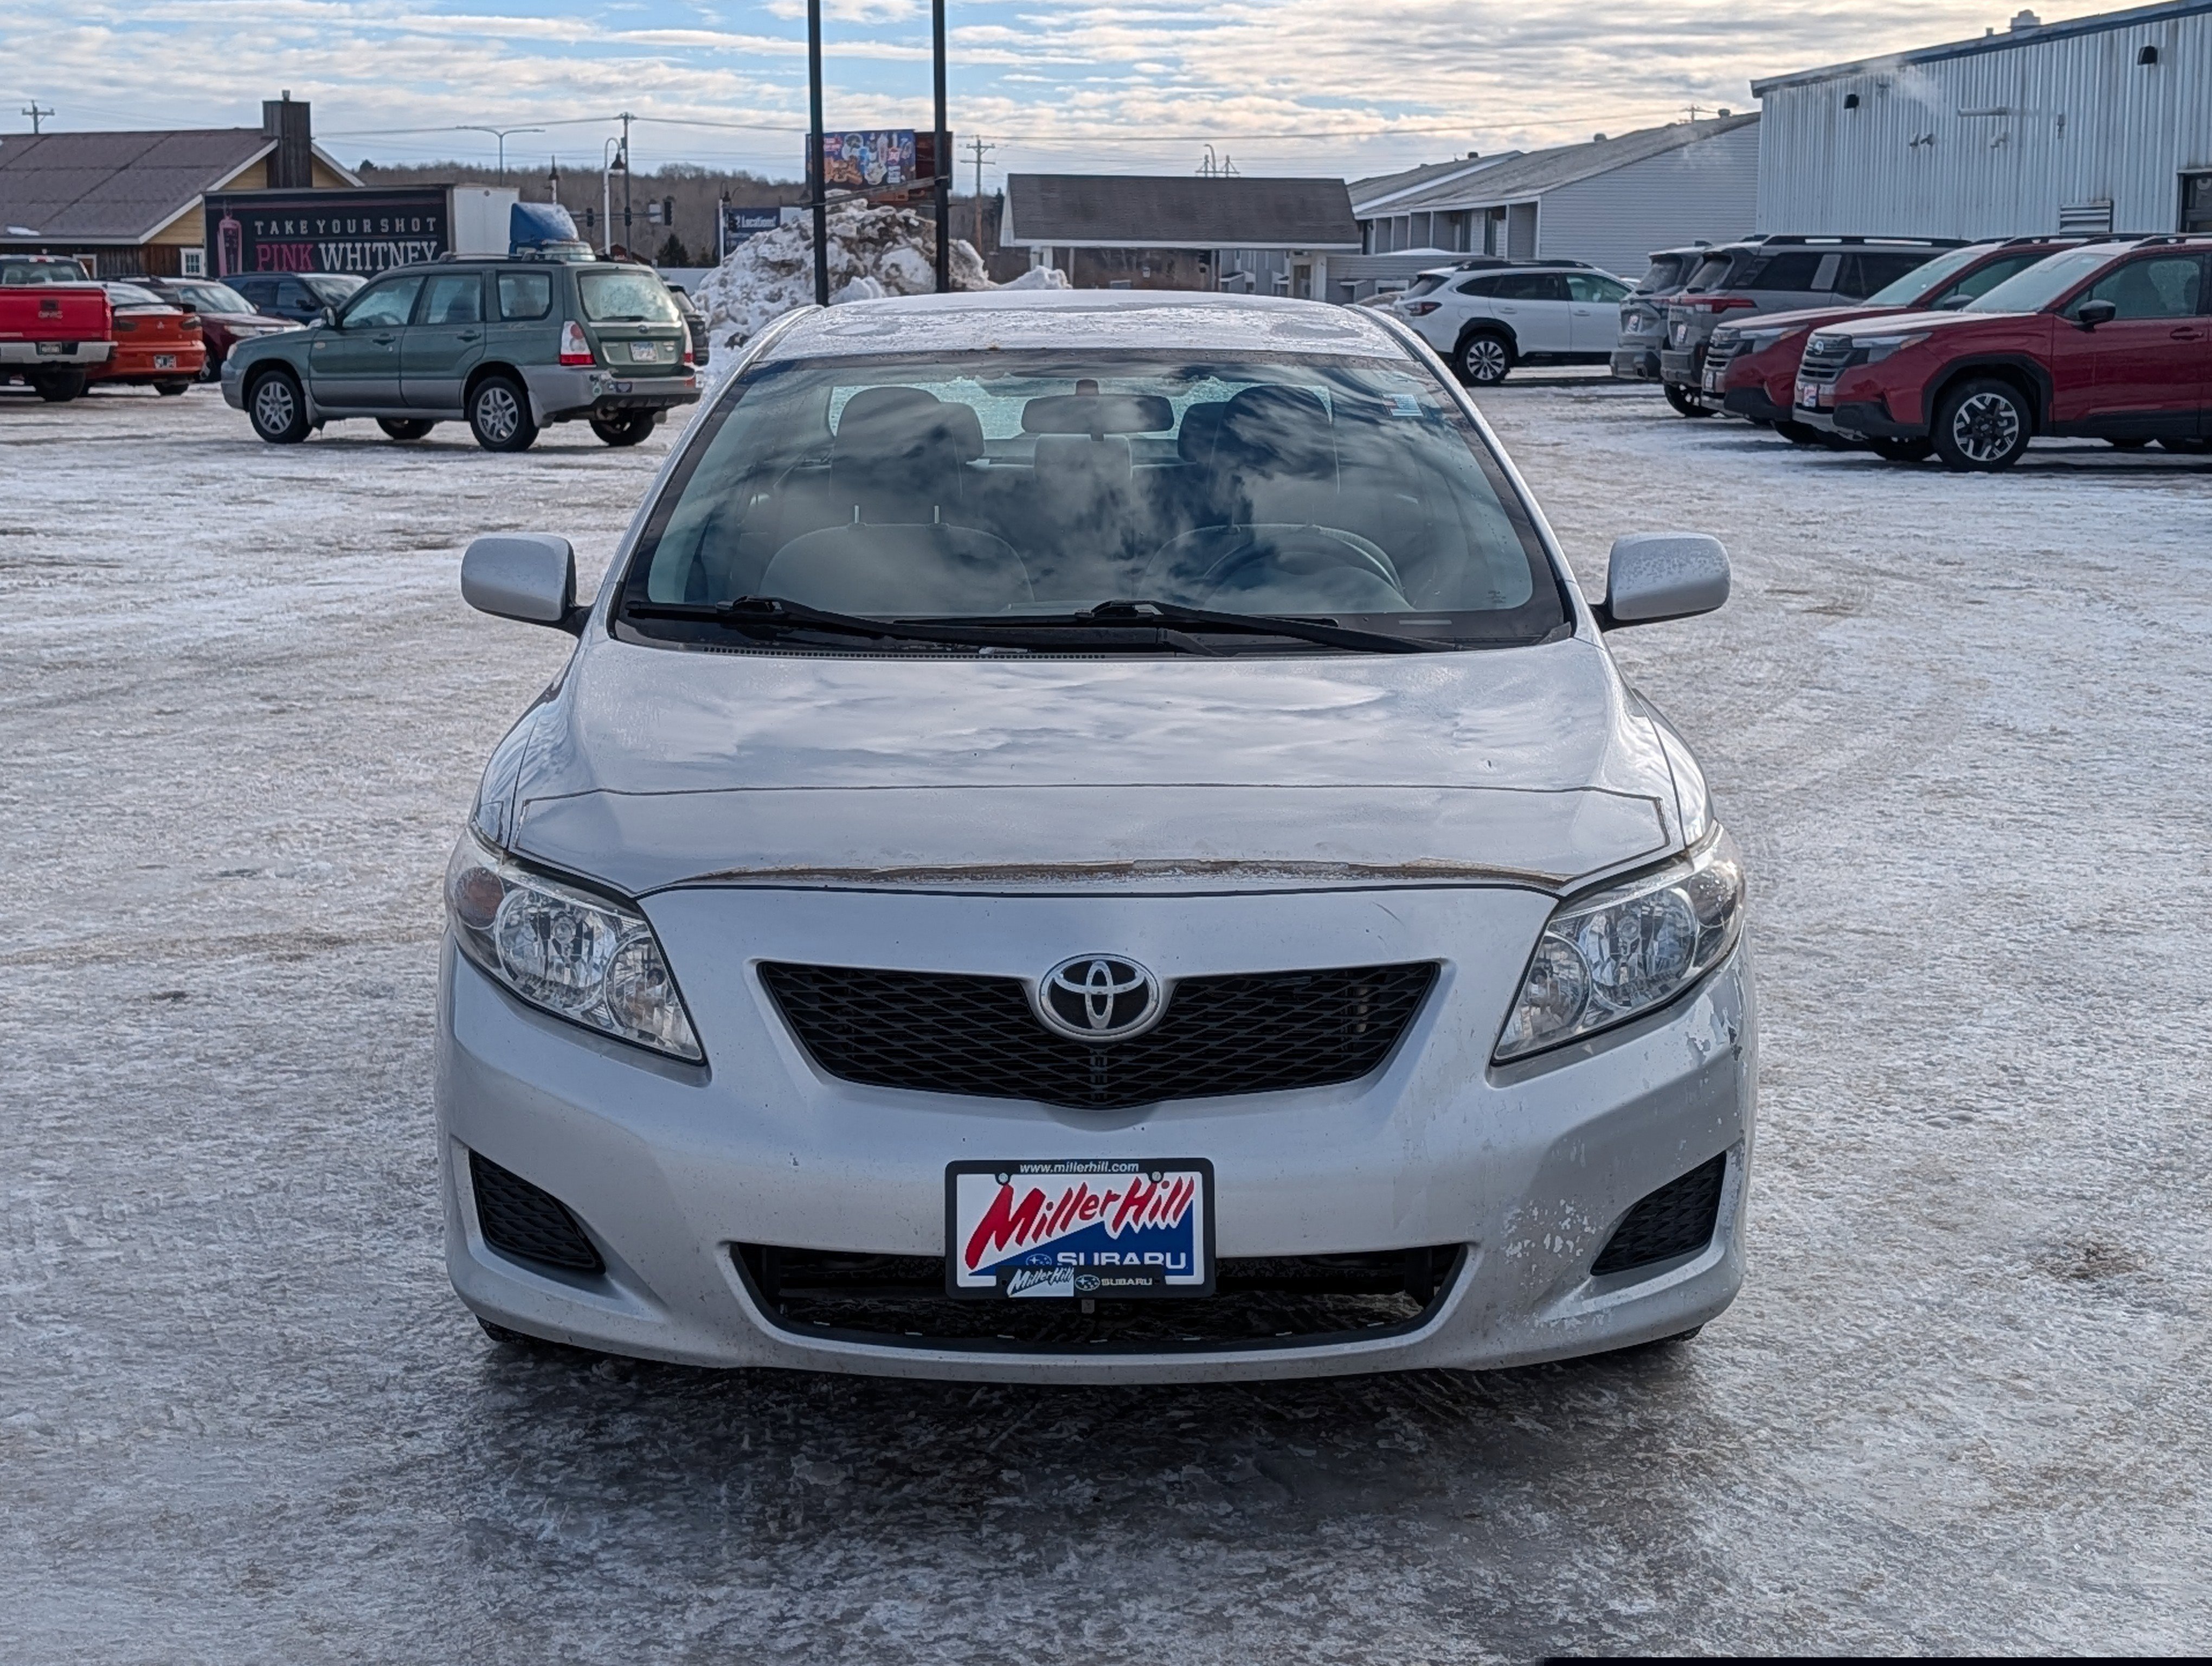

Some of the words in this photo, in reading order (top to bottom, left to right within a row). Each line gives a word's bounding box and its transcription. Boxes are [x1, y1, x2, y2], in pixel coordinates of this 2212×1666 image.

[254, 220, 308, 235] TAKE
[316, 219, 372, 234] YOUR
[380, 217, 436, 233] SHOT
[256, 244, 315, 271] PINK
[318, 241, 438, 271] WHITNEY
[1020, 1161, 1139, 1174] www.millerhill.com
[1057, 1252, 1186, 1269] SUBARU
[1101, 1277, 1153, 1286] SUBARU
